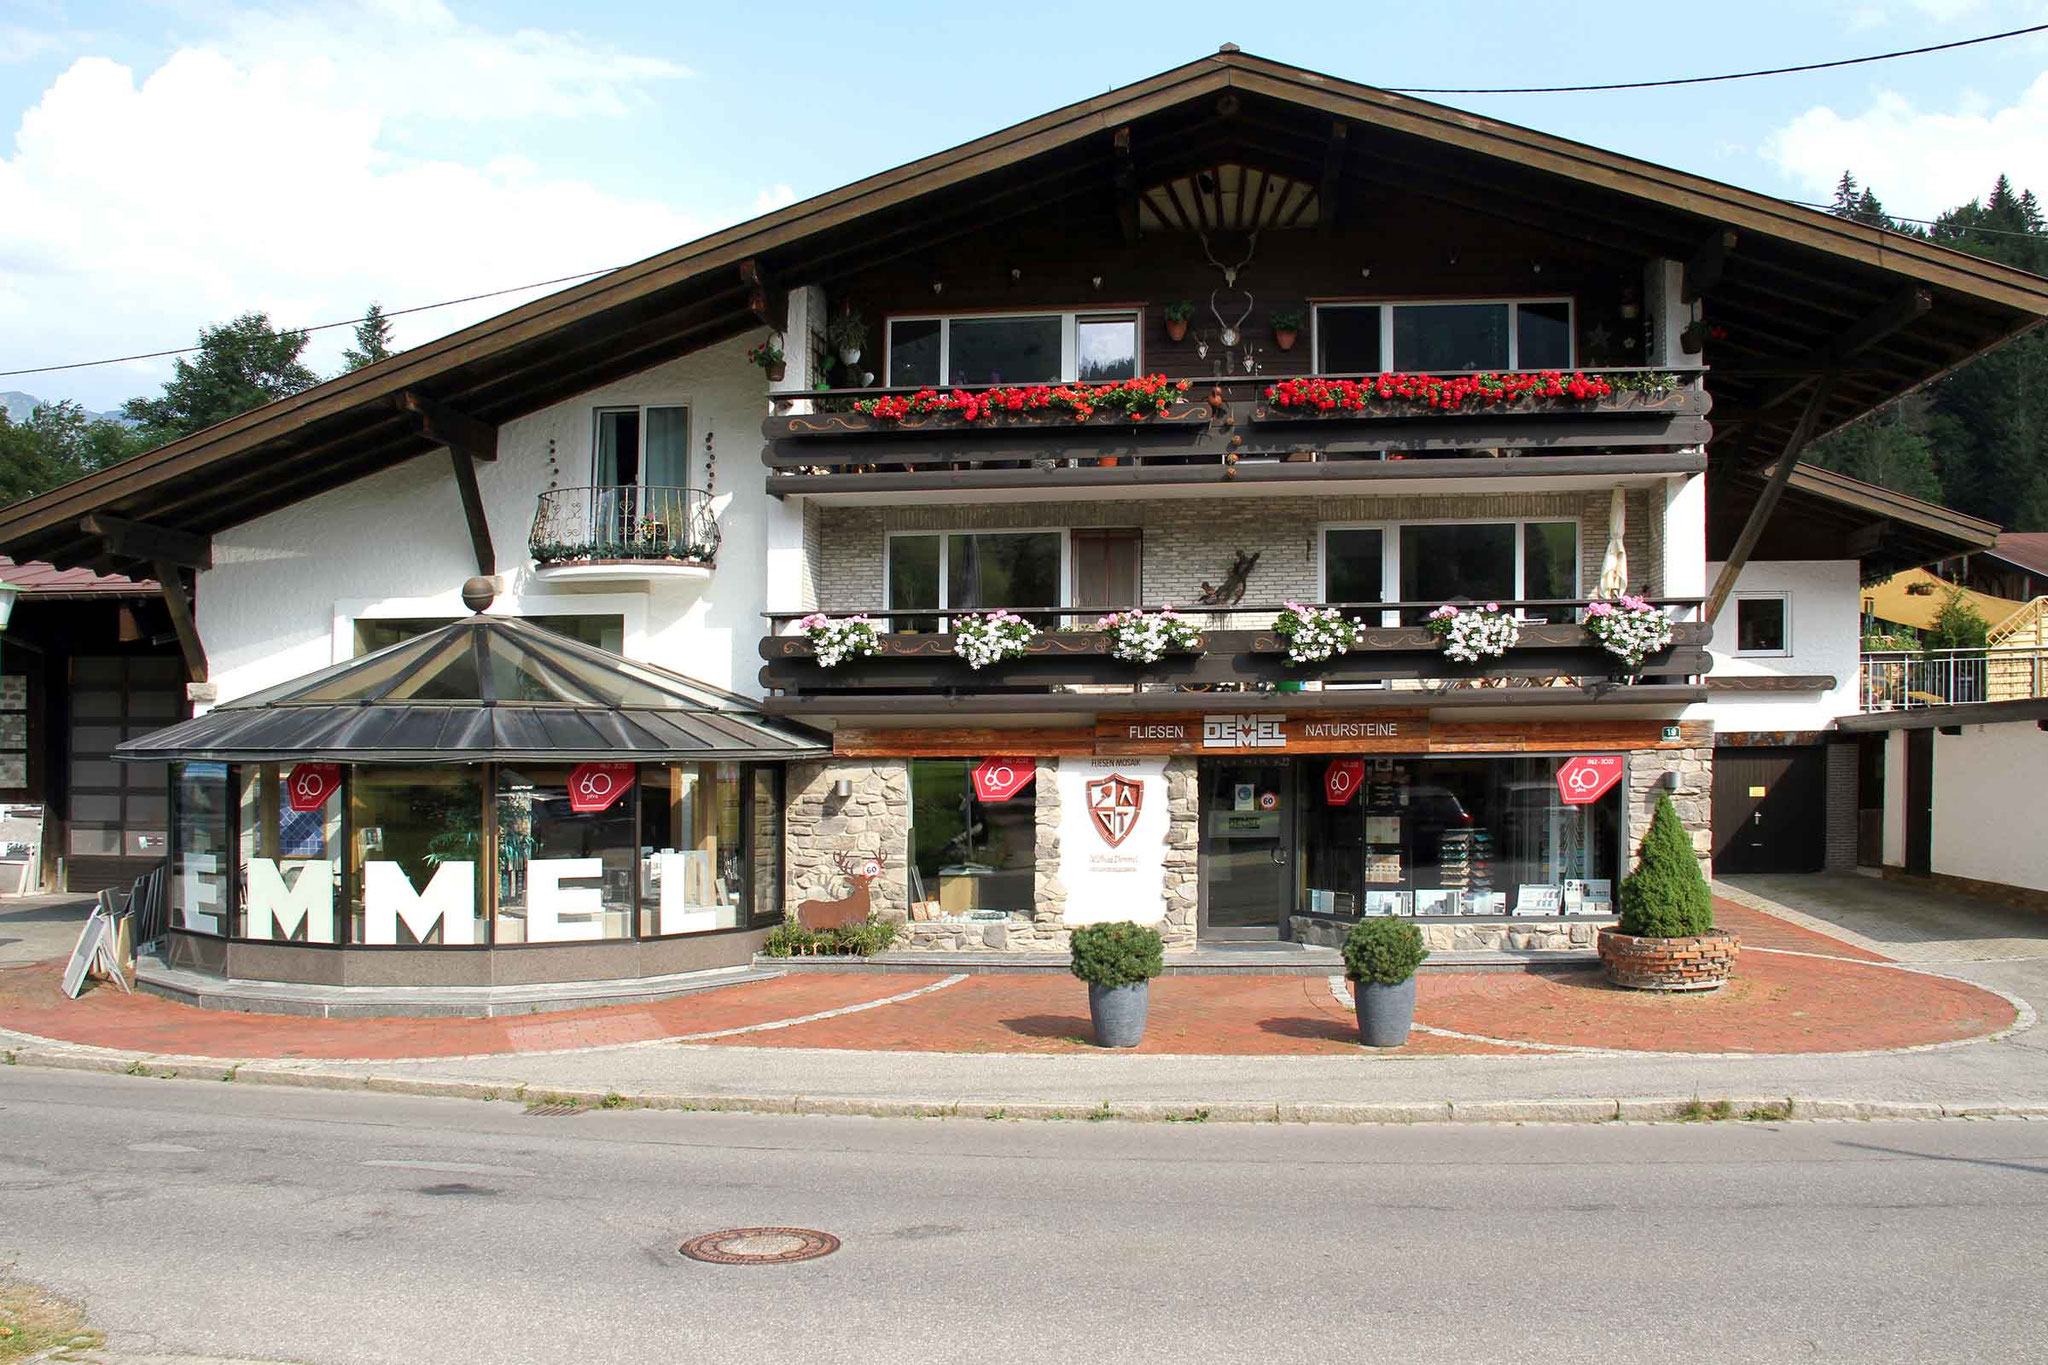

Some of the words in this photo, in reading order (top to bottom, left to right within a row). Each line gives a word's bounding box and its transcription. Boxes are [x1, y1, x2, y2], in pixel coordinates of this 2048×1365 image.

[1129, 725, 1184, 739] FLIESEN
[1305, 723, 1398, 737] NATURSTEINE
[1665, 728, 1677, 736] 19
[1091, 759, 1115, 768] FLIESEN
[1116, 758, 1141, 767] MOSAIK
[985, 766, 1014, 787] 60
[1331, 771, 1350, 791] 60
[1569, 768, 1599, 789] 60
[297, 773, 323, 796] 60
[580, 773, 612, 795] 60
[1263, 797, 1273, 805] 60
[866, 866, 877, 874] 60
